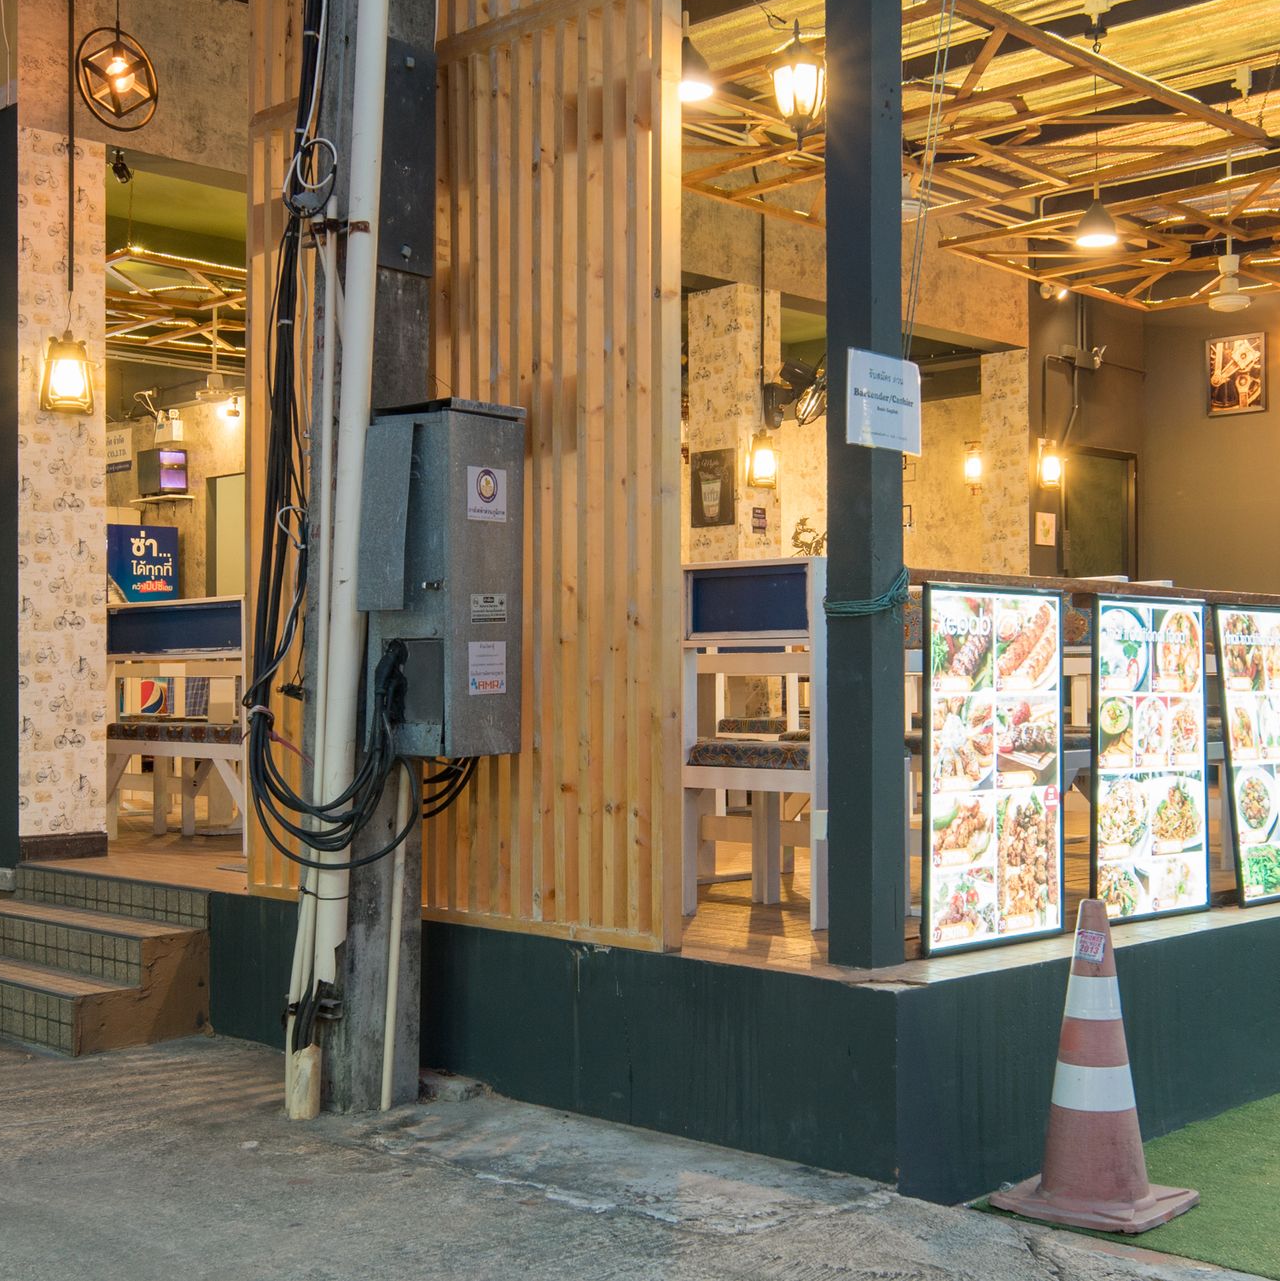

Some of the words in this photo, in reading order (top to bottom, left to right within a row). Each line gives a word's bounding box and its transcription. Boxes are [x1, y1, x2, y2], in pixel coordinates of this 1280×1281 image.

[131, 558, 172, 580] ได้ทุกที่
[940, 607, 992, 637] kebab
[1079, 944, 1100, 955] 2013
